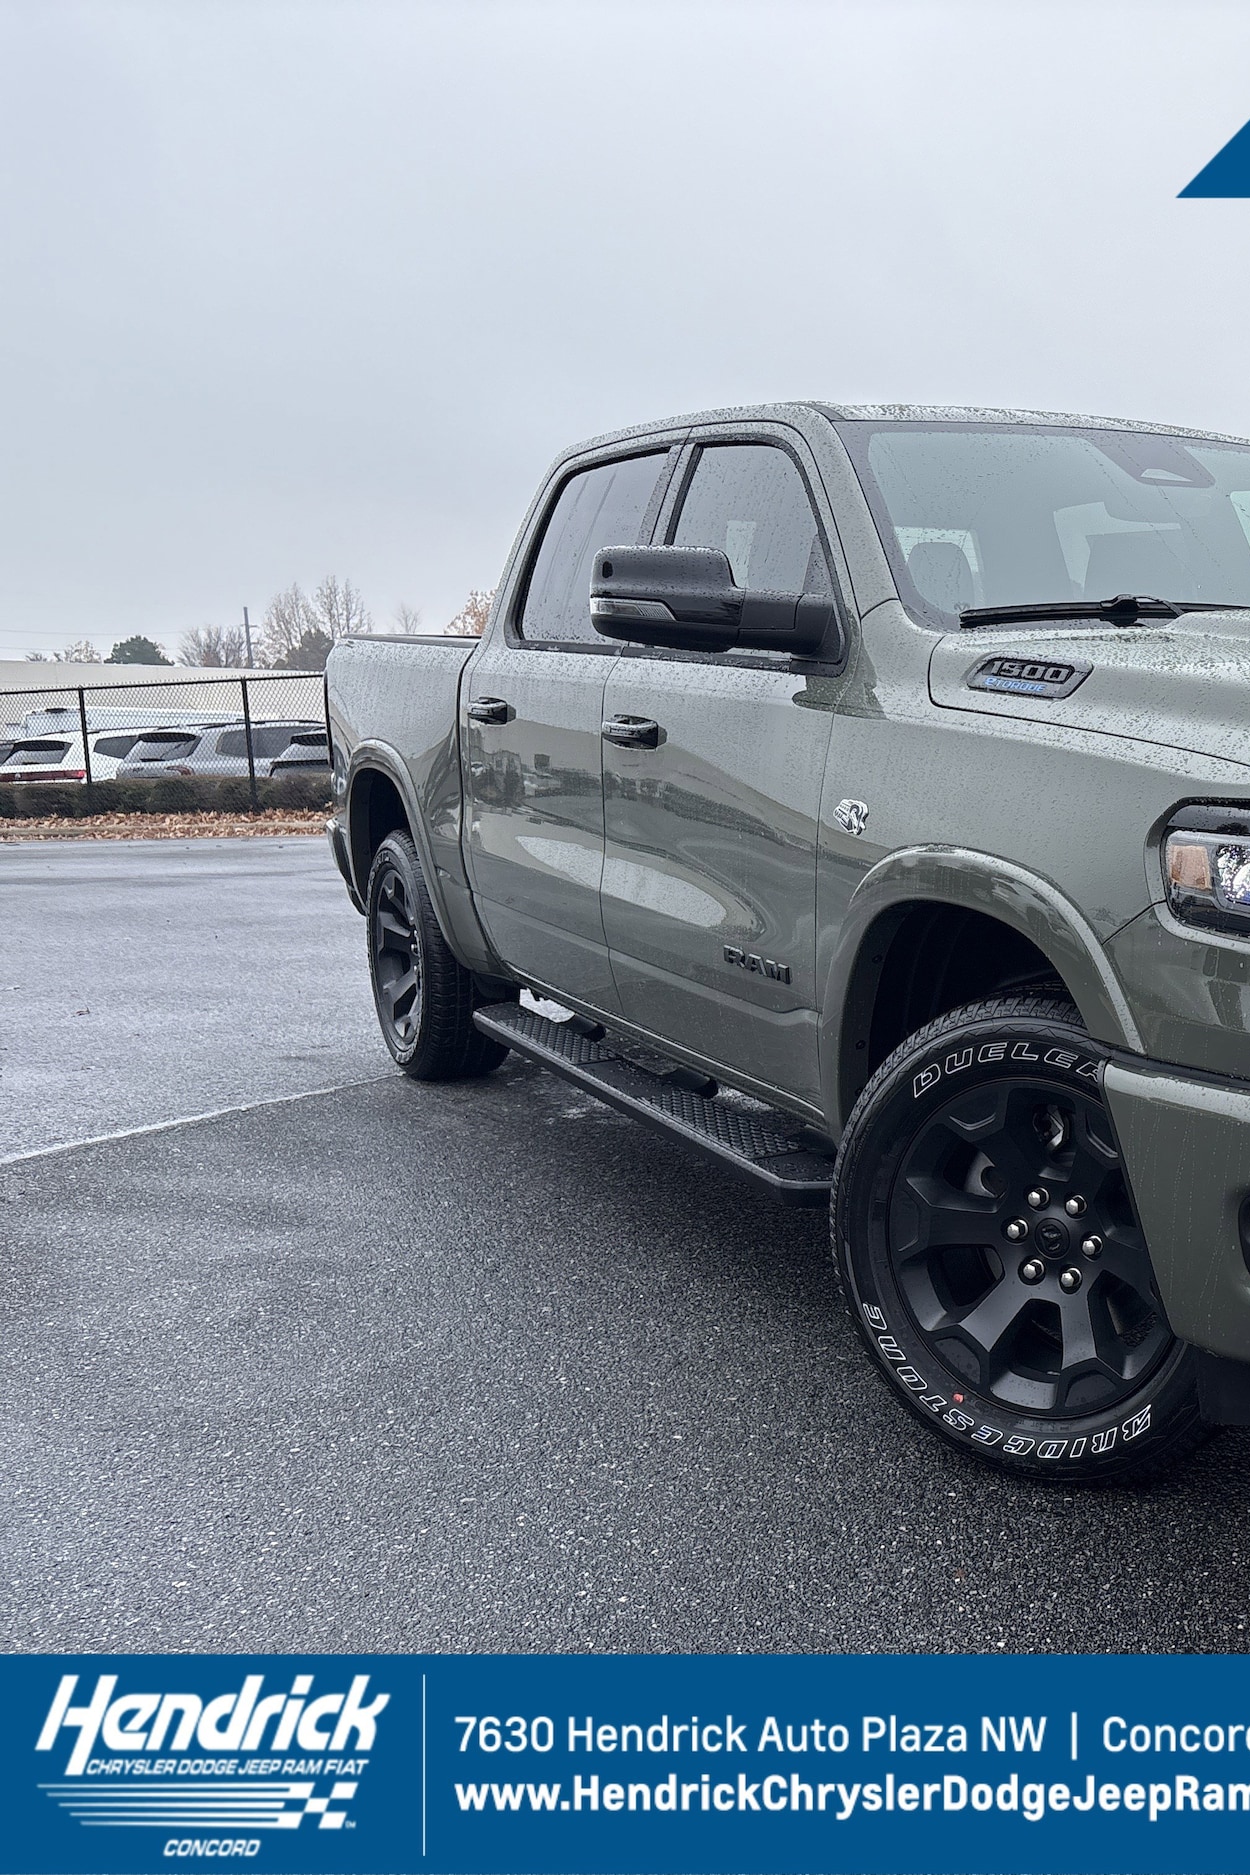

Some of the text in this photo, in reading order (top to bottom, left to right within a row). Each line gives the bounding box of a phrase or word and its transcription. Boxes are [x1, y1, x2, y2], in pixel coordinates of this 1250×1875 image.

[988, 660, 1070, 683] 1500
[723, 944, 791, 985] RAM
[862, 1301, 1152, 1459] BRIDGESTONE
